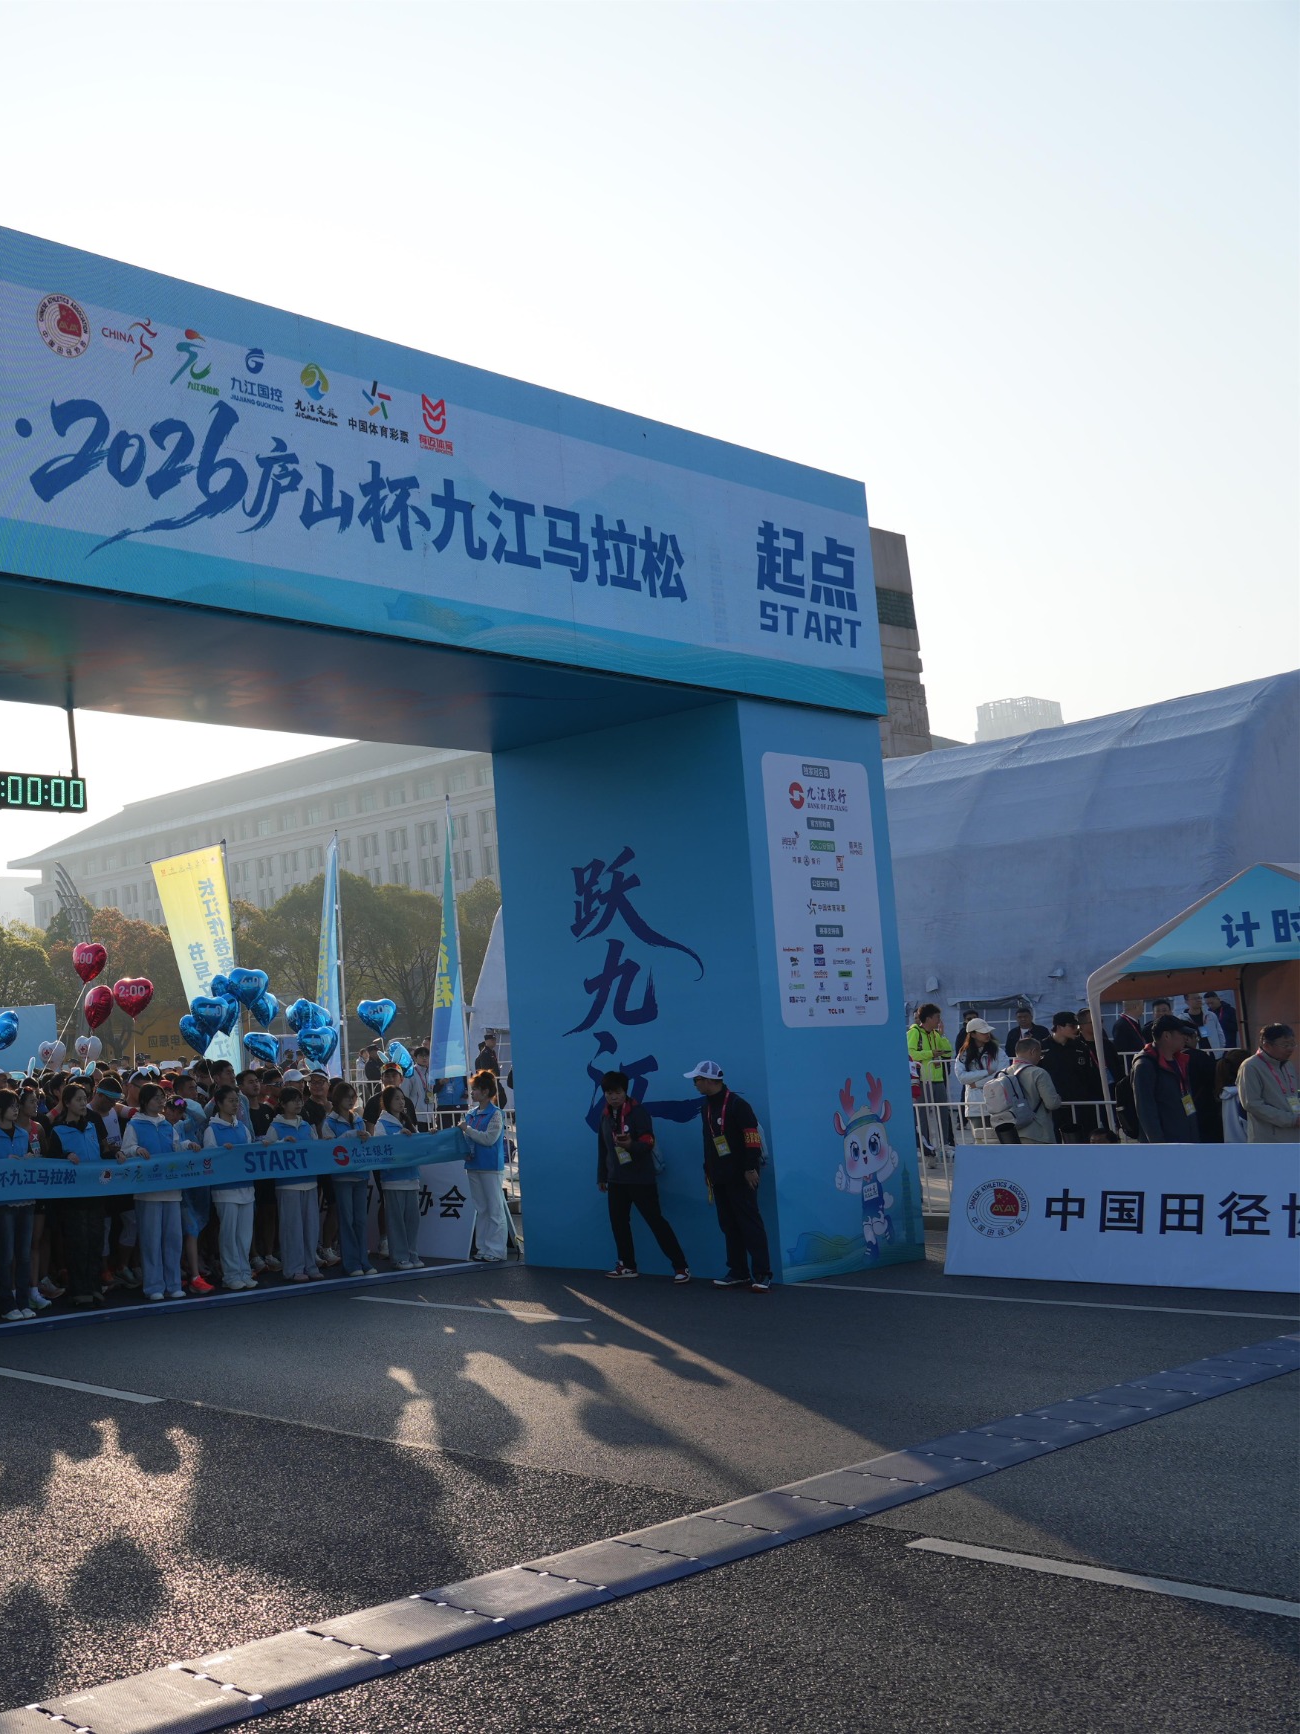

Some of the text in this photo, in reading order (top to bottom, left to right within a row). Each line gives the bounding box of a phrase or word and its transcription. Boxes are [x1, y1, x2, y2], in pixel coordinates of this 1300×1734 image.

[101, 326, 135, 345] CHINA
[187, 381, 220, 397] 九江马拉松
[230, 377, 283, 403] 九江国控
[230, 394, 284, 412] JIUJIANG GUOKONG
[347, 417, 410, 444] 中国体育彩票
[756, 520, 858, 612] 起点
[760, 600, 862, 649] START
[806, 786, 847, 805] 九江银行
[118, 984, 147, 998] 2:00
[351, 1144, 394, 1158] 九江银行
[243, 1148, 308, 1174] START
[981, 1181, 1008, 1192] ATHLETICS
